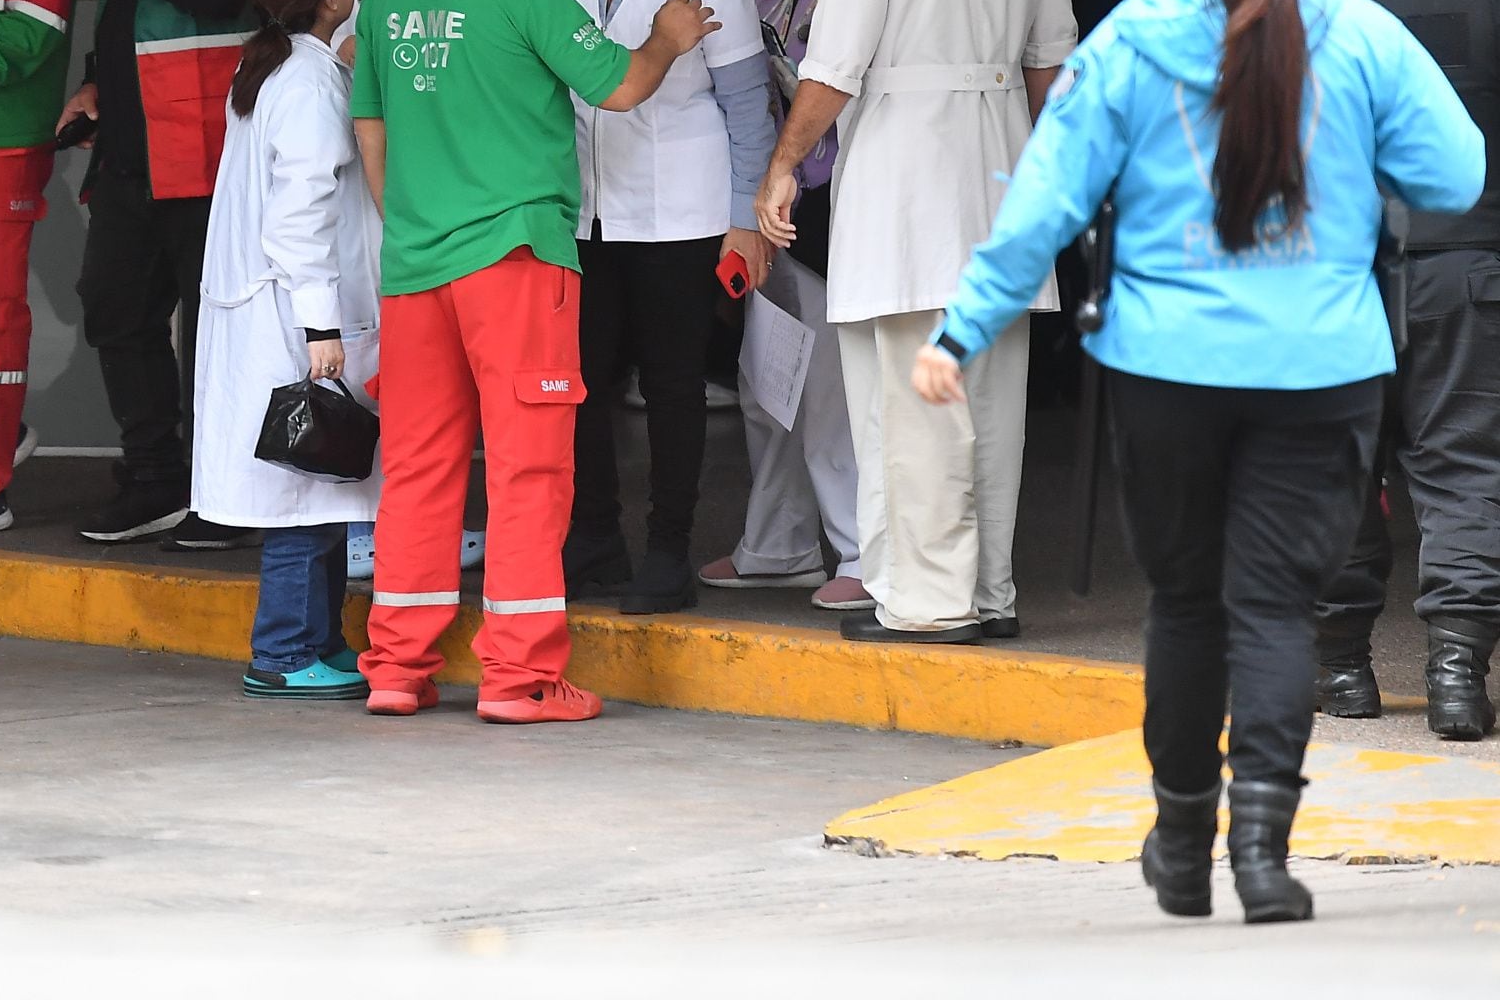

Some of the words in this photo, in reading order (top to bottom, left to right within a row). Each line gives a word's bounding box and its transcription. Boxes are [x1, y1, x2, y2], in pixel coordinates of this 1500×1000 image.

[386, 10, 466, 40] SAME
[420, 42, 451, 69] 107
[540, 379, 570, 392] SAME
